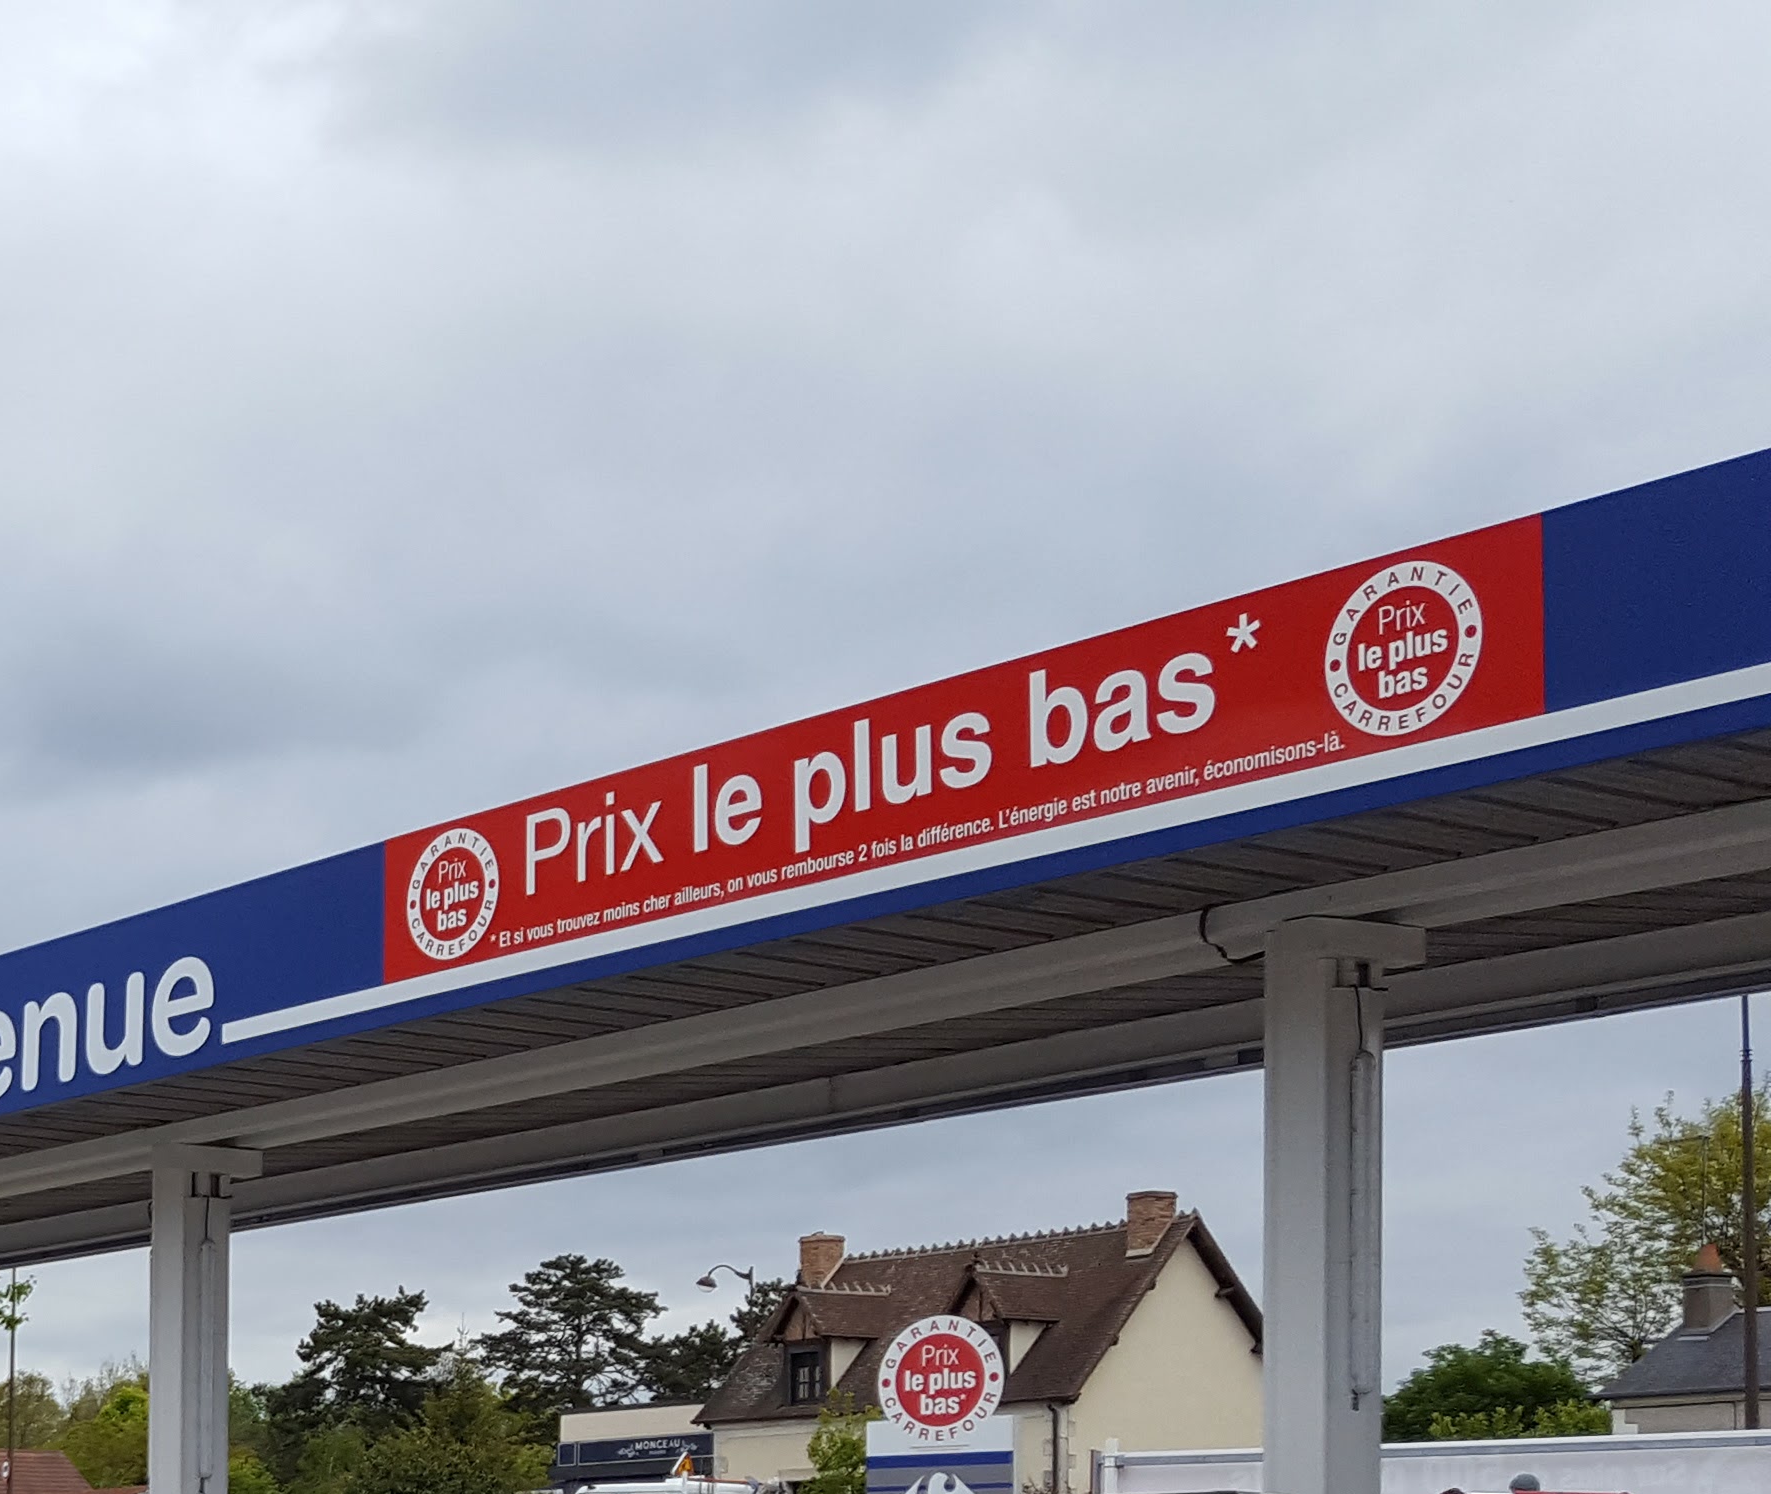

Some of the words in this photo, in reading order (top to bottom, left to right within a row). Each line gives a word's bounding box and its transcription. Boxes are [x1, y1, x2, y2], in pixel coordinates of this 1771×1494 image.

[1333, 566, 1474, 646] GARANTIE
[1378, 600, 1426, 635] Prix
[1358, 642, 1383, 671] le
[1388, 628, 1449, 671] plus
[1334, 652, 1474, 732] CARREFOUR
[1378, 666, 1428, 699] bas
[526, 791, 664, 896] Prix
[693, 763, 762, 853] le
[794, 711, 992, 854] plus
[499, 930, 512, 948] Et
[514, 927, 524, 945] si
[526, 922, 554, 943] vous
[557, 912, 600, 933] trouvez
[603, 901, 640, 923] moins
[643, 890, 671, 913] cher
[674, 881, 725, 906] ailleurs,
[727, 876, 744, 894] on
[746, 869, 778, 888] vous
[781, 849, 854, 881] rembourse
[858, 844, 868, 862] 2
[871, 836, 897, 859] fois
[900, 834, 913, 852] la
[917, 818, 994, 848] différence.
[1072, 789, 1097, 812] est
[1100, 779, 1142, 805] notre
[1146, 766, 1199, 793] avenir,
[1203, 730, 1345, 782] économisons-là.
[412, 832, 495, 890] GARANTIE
[438, 858, 467, 884] Prix
[426, 888, 440, 911] le
[444, 880, 479, 911] plus
[412, 899, 495, 957] CARREFOUR
[437, 908, 467, 932] bas
[886, 1320, 996, 1368] GARANTIE
[921, 1344, 959, 1366] Prix
[904, 1370, 924, 1391] le
[929, 1368, 976, 1394] plus
[885, 1392, 997, 1441] CARREFOUR
[635, 1439, 681, 1450] MONCEAU
